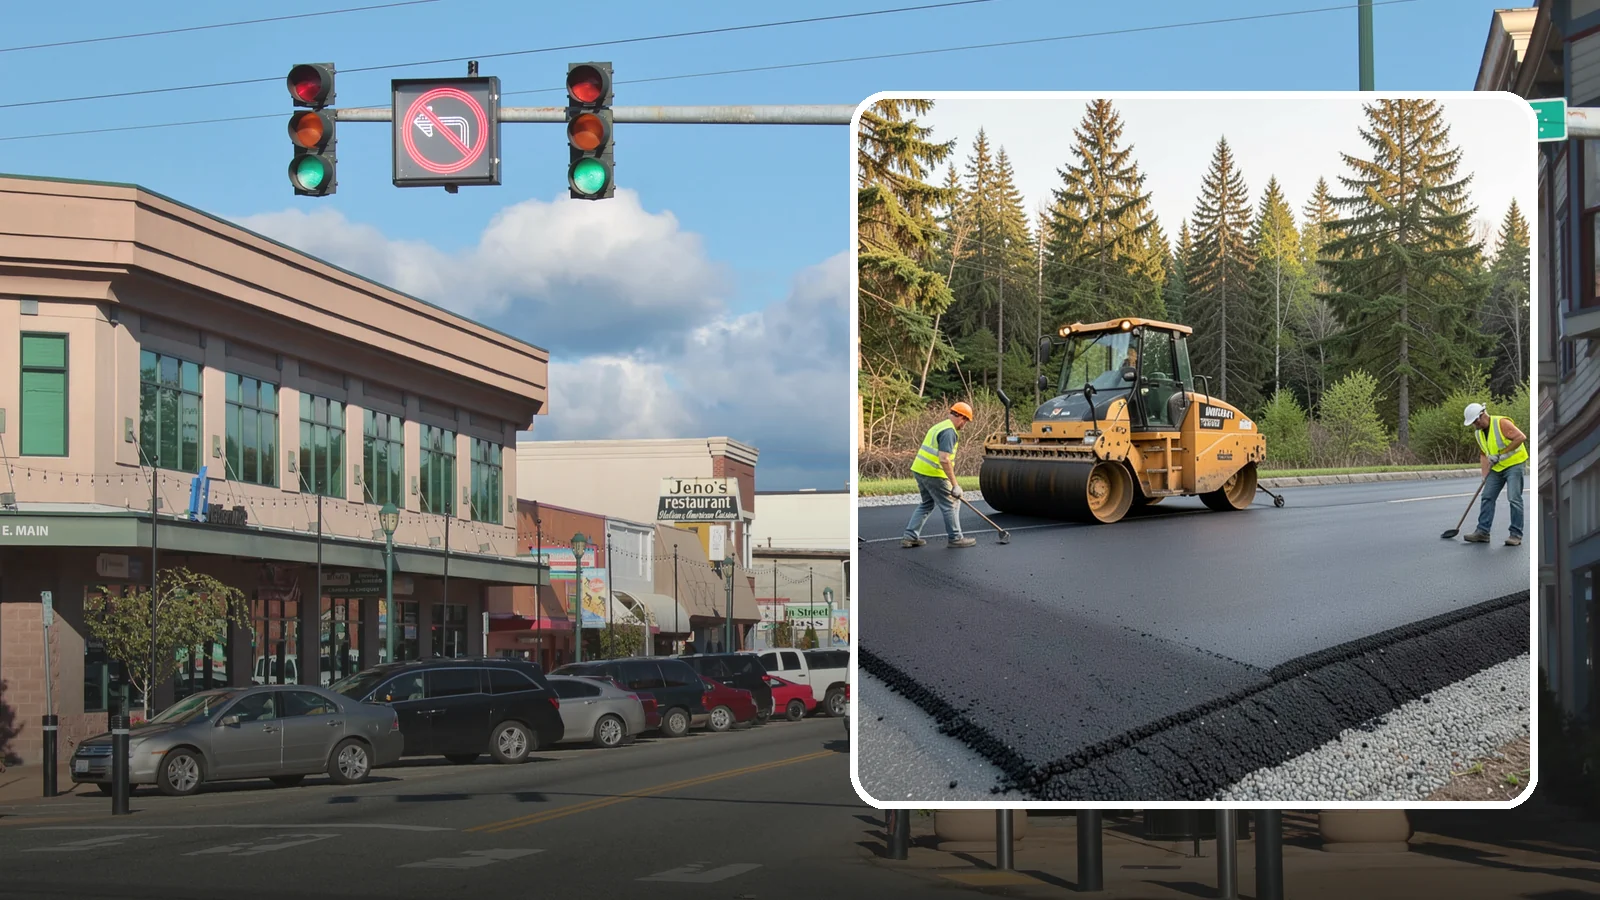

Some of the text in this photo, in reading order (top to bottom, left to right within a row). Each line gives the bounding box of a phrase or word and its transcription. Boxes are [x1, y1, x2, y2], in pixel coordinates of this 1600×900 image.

[669, 480, 728, 495] Jeno's
[665, 496, 731, 509] restaurant
[658, 509, 681, 519] Italian
[686, 509, 714, 519] American
[715, 509, 737, 519] Cuisine
[2, 525, 49, 536] E. MAIN
[797, 607, 828, 617] Street
[790, 619, 823, 627] lass
